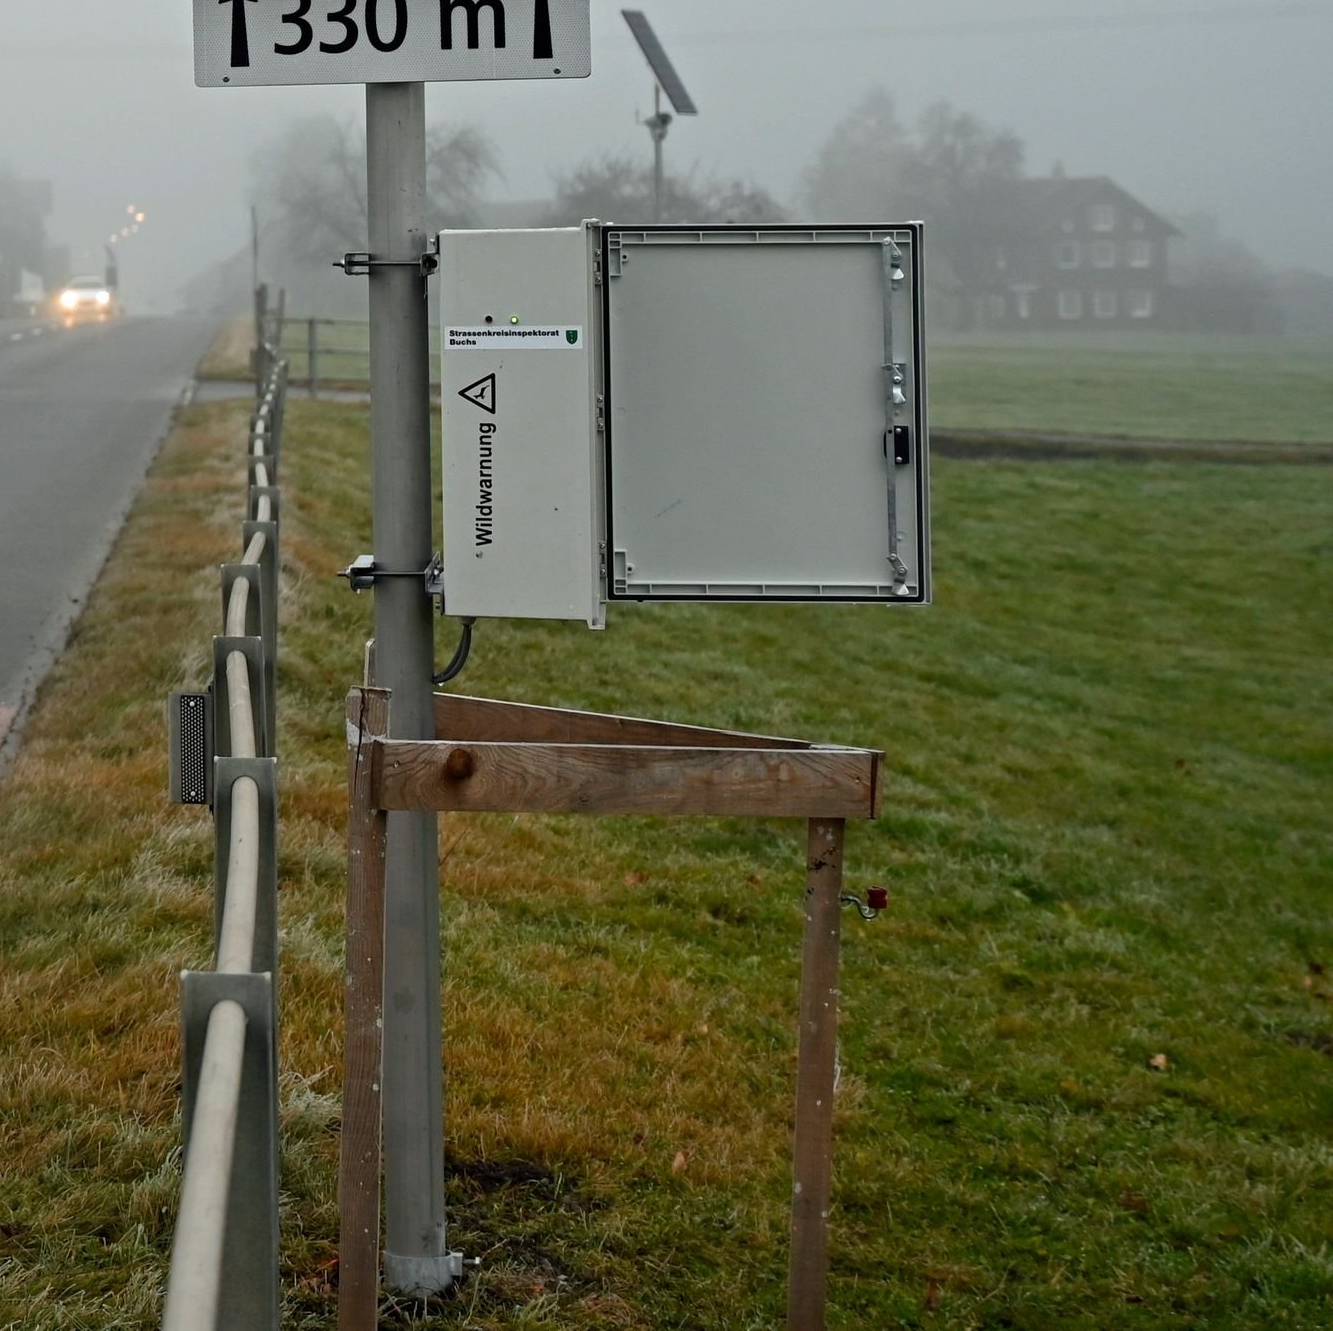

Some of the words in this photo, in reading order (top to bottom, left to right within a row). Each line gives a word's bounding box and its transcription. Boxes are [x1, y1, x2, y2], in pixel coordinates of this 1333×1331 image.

[449, 329, 560, 338] Strassenkreisinspektorat
[449, 338, 477, 346] Buchs
[475, 422, 497, 547] Wildwarnung
